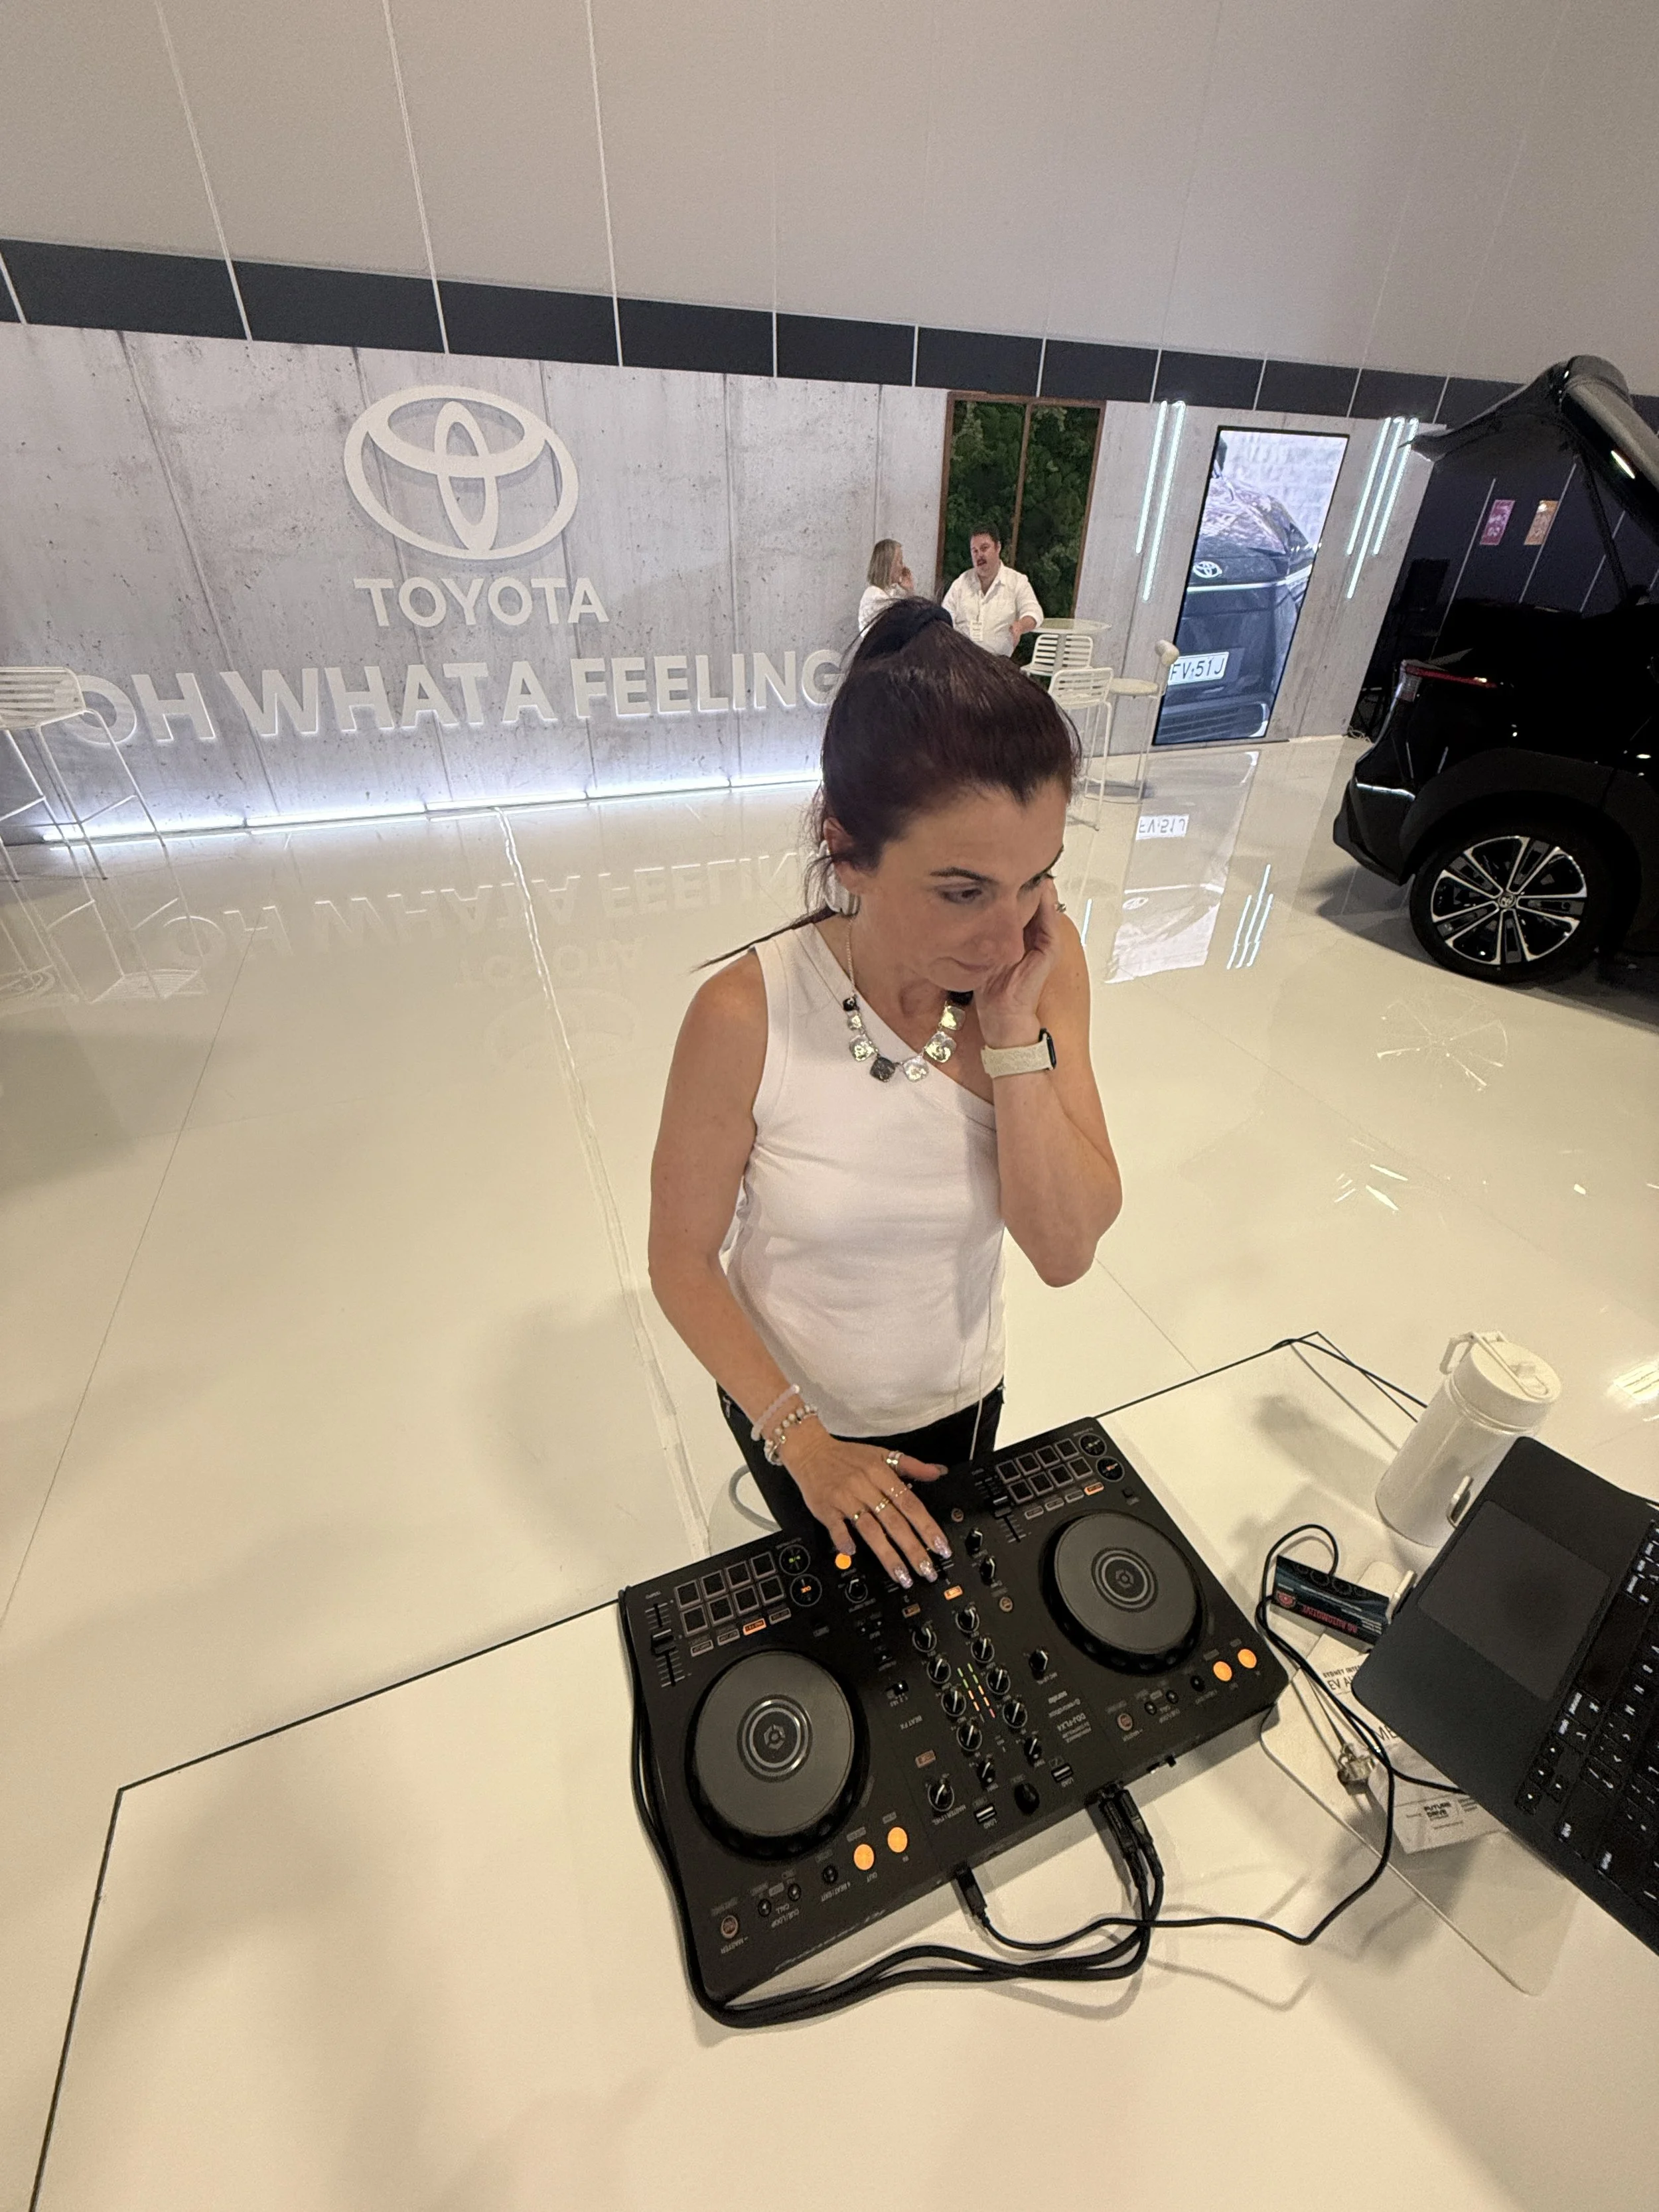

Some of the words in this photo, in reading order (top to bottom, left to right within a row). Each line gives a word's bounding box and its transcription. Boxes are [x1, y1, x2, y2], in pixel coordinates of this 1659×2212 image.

[354, 576, 610, 627] TOYOTA
[61, 672, 216, 745] OH
[570, 649, 841, 718] FEELING
[1327, 1678, 1341, 1690] EV
